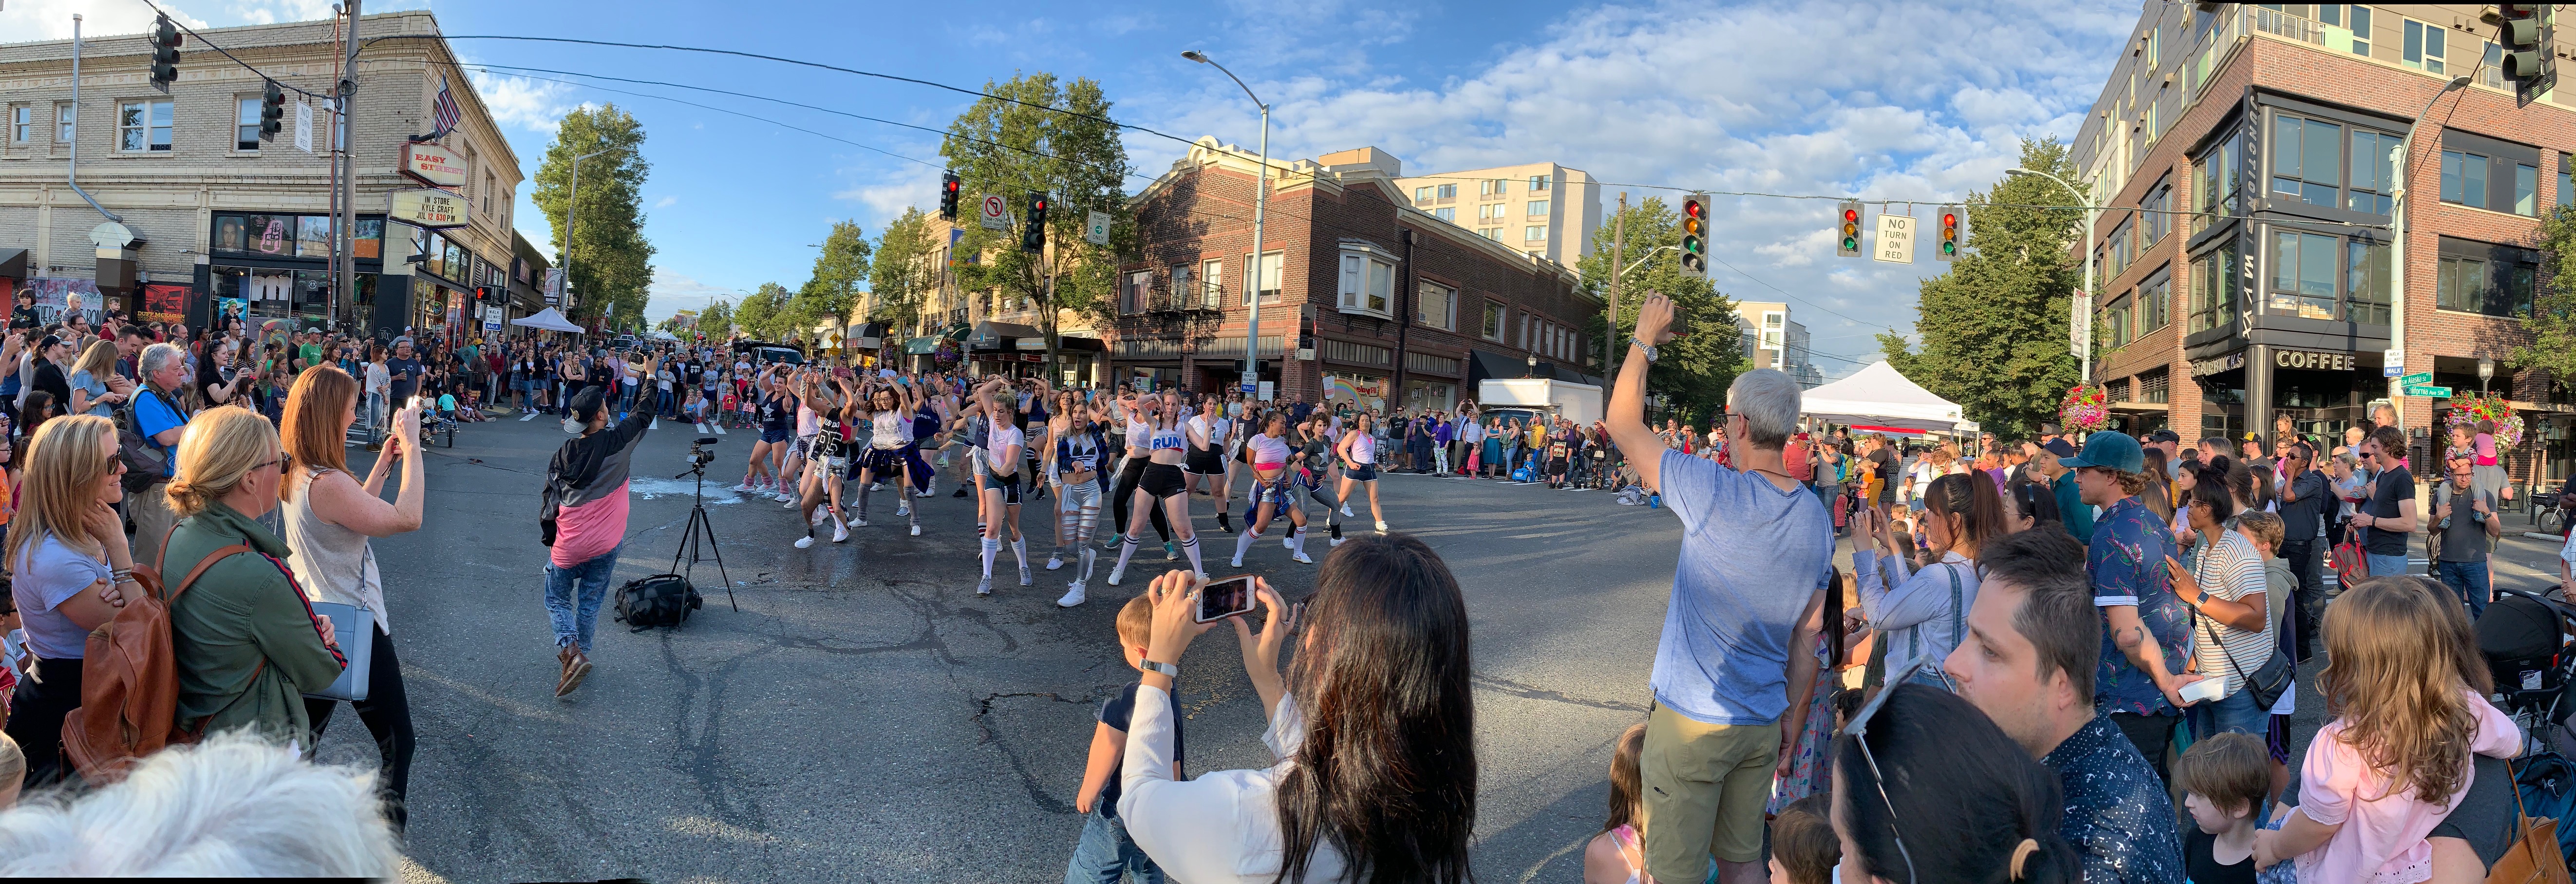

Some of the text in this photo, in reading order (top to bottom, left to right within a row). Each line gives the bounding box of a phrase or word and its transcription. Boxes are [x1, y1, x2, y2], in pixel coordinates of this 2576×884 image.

[301, 106, 309, 118] NO
[300, 117, 310, 129] TURN
[301, 129, 307, 137] ON
[415, 154, 446, 164] EASY
[2247, 96, 2257, 212] JUNCTION
[421, 163, 464, 175] STREET
[433, 197, 450, 205] STORE
[421, 204, 454, 214] KYLE CRAFT
[436, 213, 446, 221] 630
[1888, 218, 1905, 230] NO
[1884, 230, 1907, 240] TURN
[1889, 241, 1900, 249] ON
[1885, 250, 1902, 259] RED
[33, 305, 54, 323] OTHER
[2191, 352, 2244, 377] STARBUCKS
[2276, 350, 2355, 371] COFFEE
[2408, 376, 2422, 384] Alaska
[1419, 389, 1422, 398] IT
[2405, 386, 2428, 395] California
[1153, 437, 1182, 449] RUN
